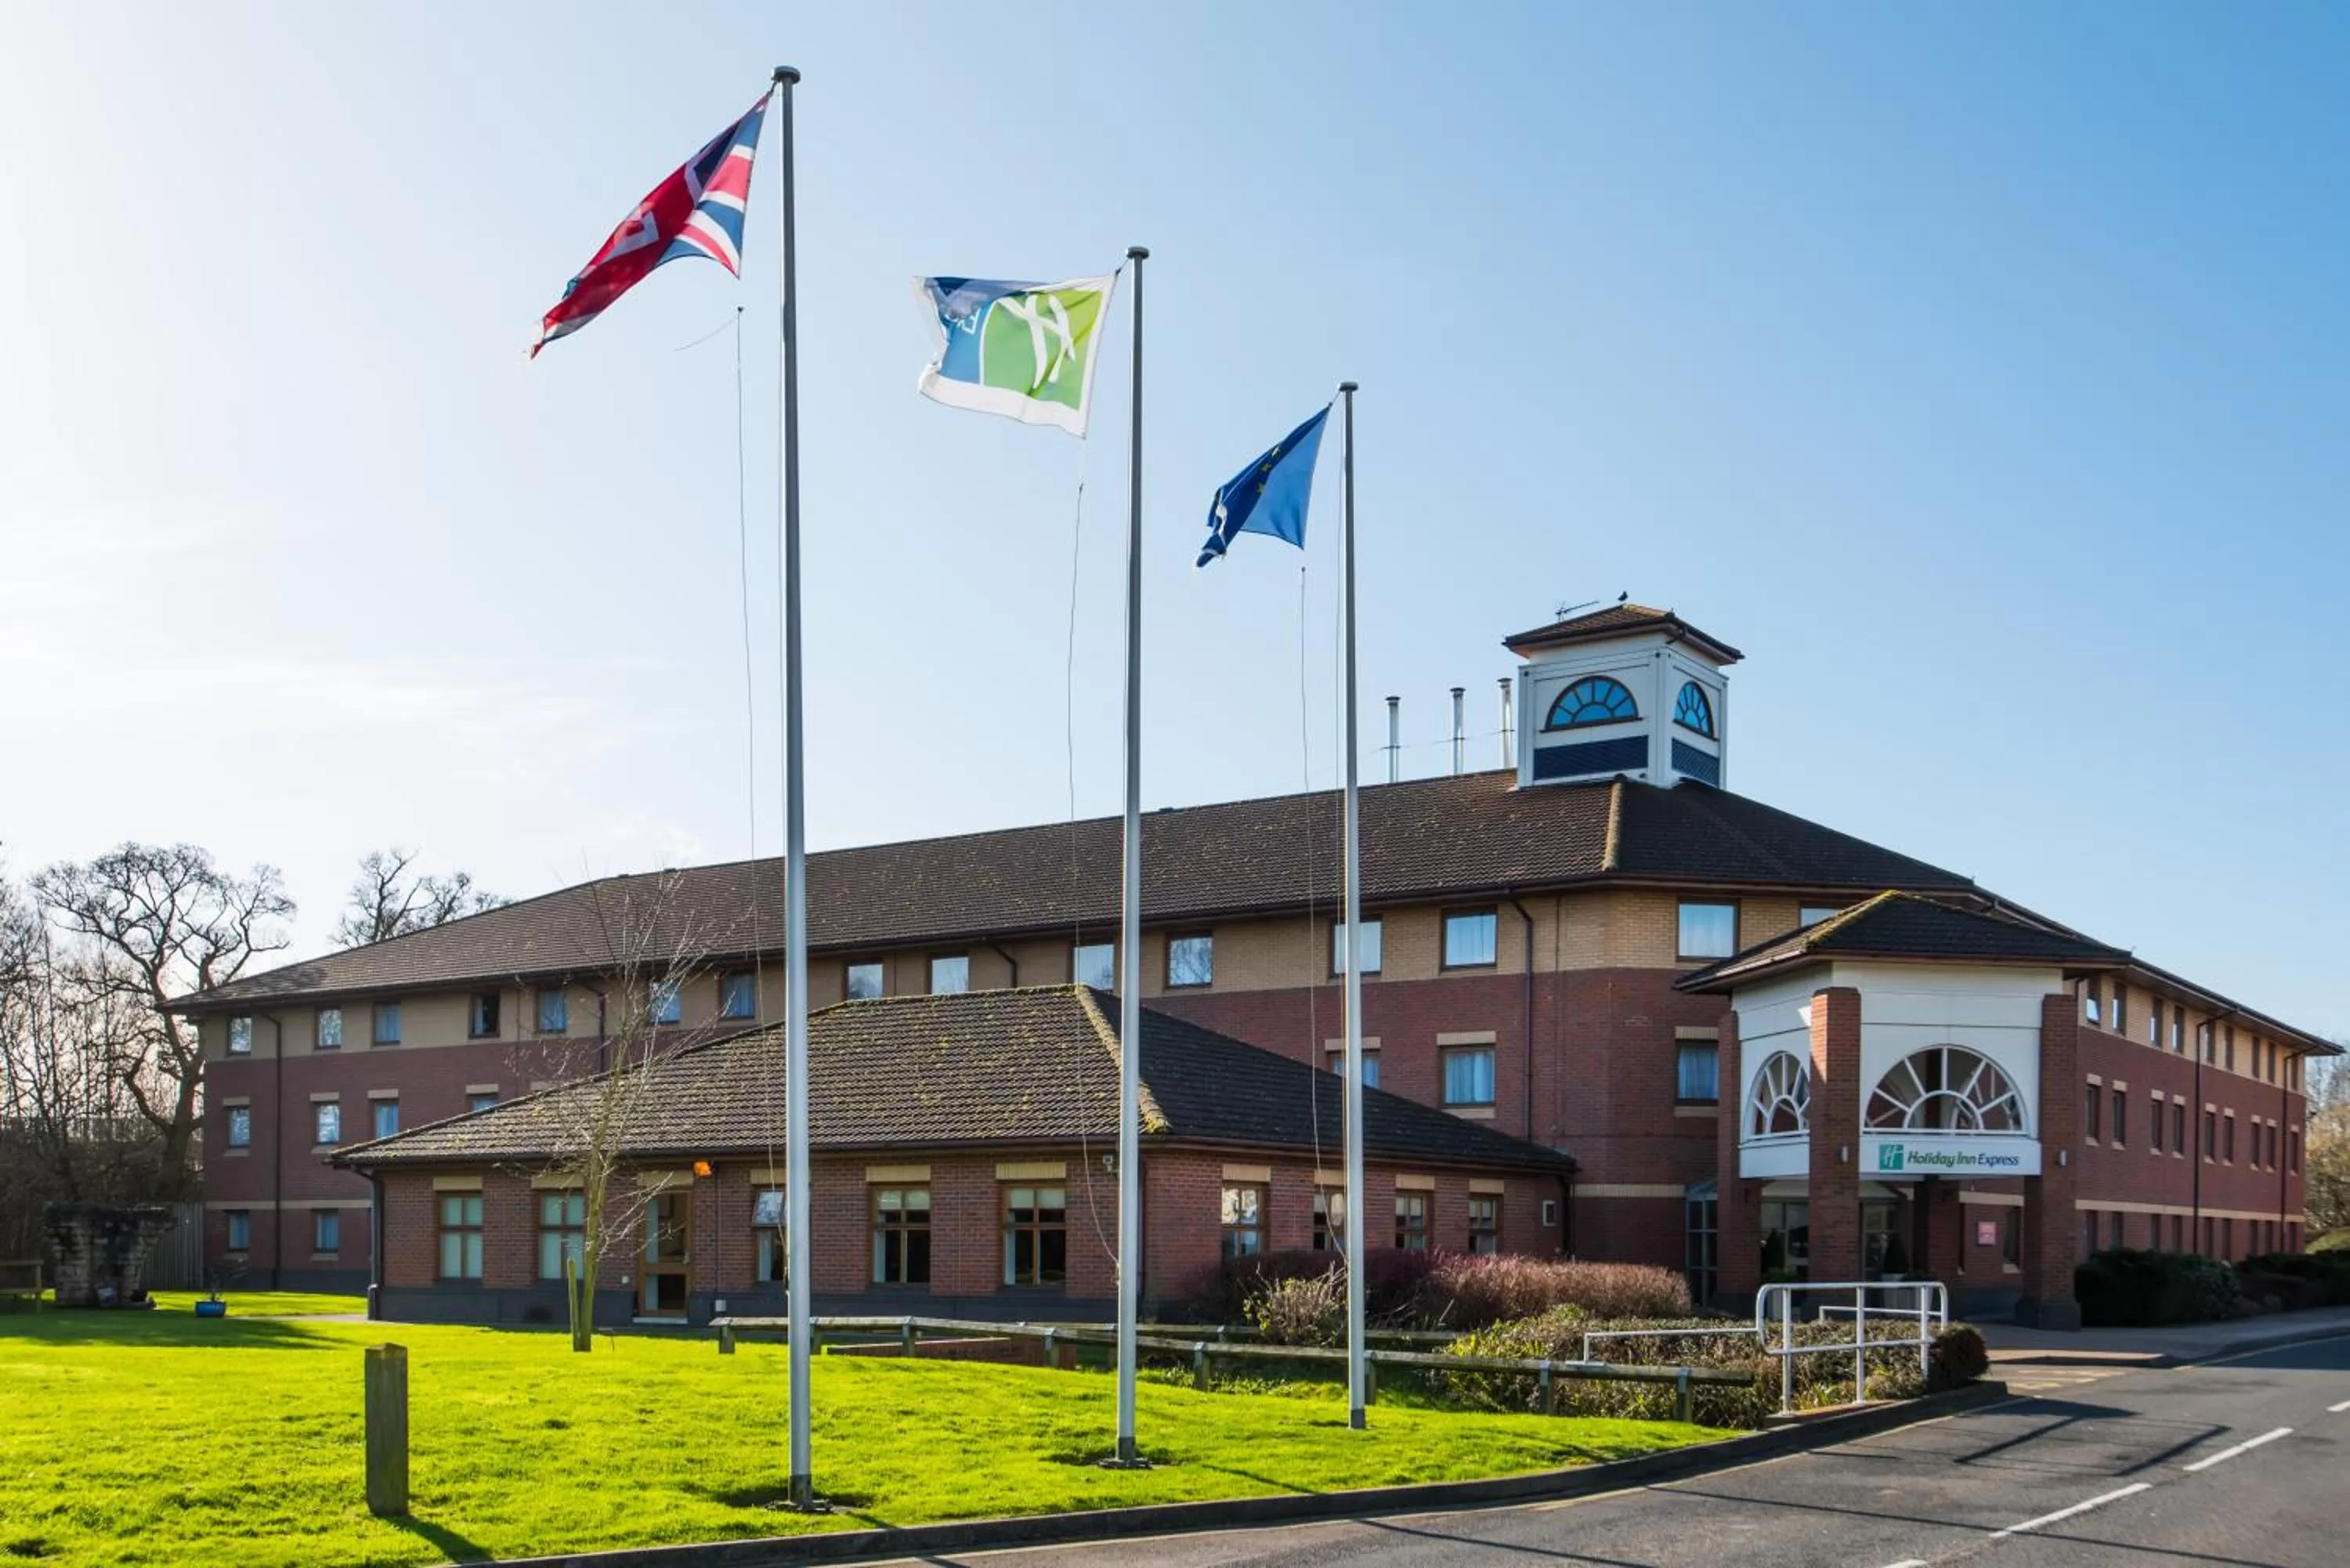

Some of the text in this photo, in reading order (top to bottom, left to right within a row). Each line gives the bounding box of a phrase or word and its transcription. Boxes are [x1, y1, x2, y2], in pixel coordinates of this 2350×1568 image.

[1907, 1151, 2019, 1168] Holiday Inn Express
